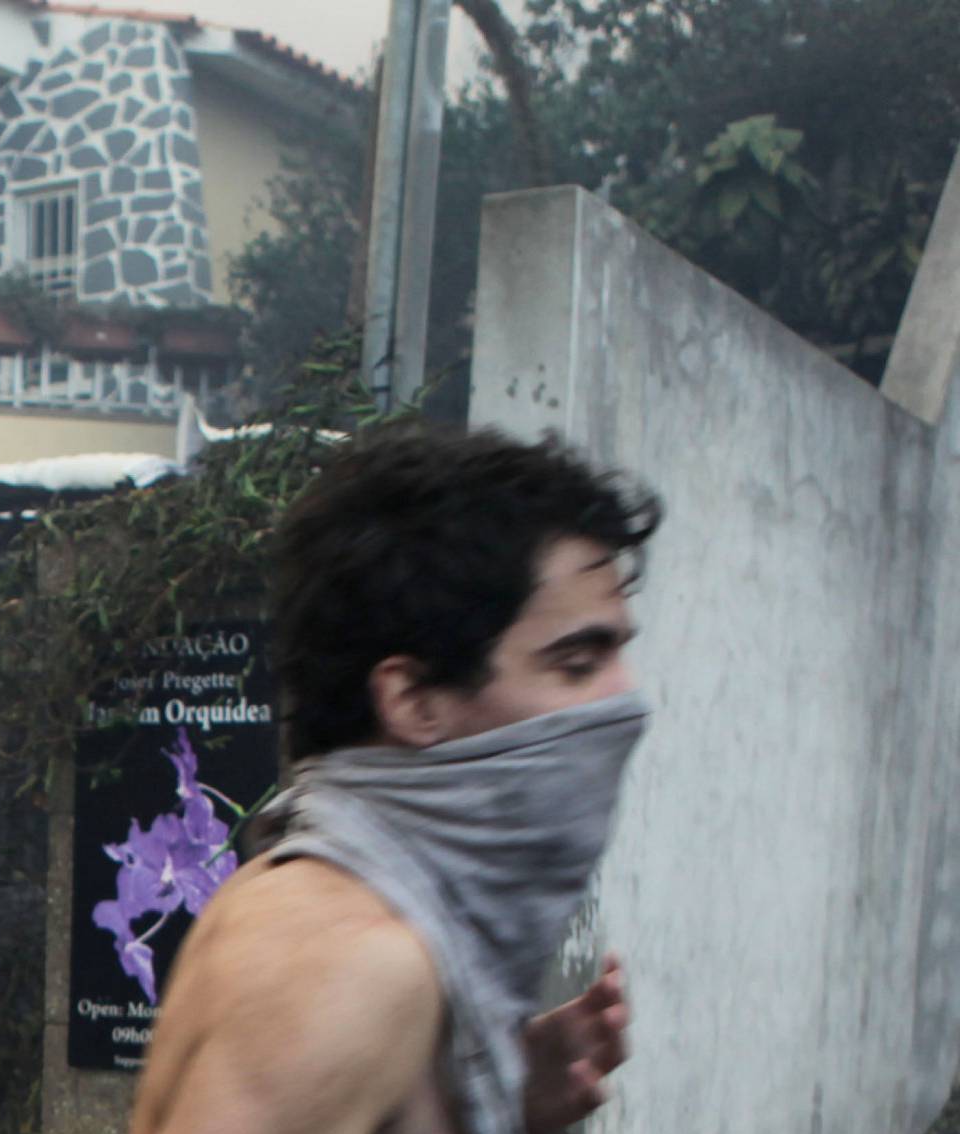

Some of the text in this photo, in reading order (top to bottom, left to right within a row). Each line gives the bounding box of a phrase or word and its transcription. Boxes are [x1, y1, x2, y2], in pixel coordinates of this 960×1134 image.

[164, 695, 272, 731] Orquídea
[77, 998, 164, 1021] Open: Mon
